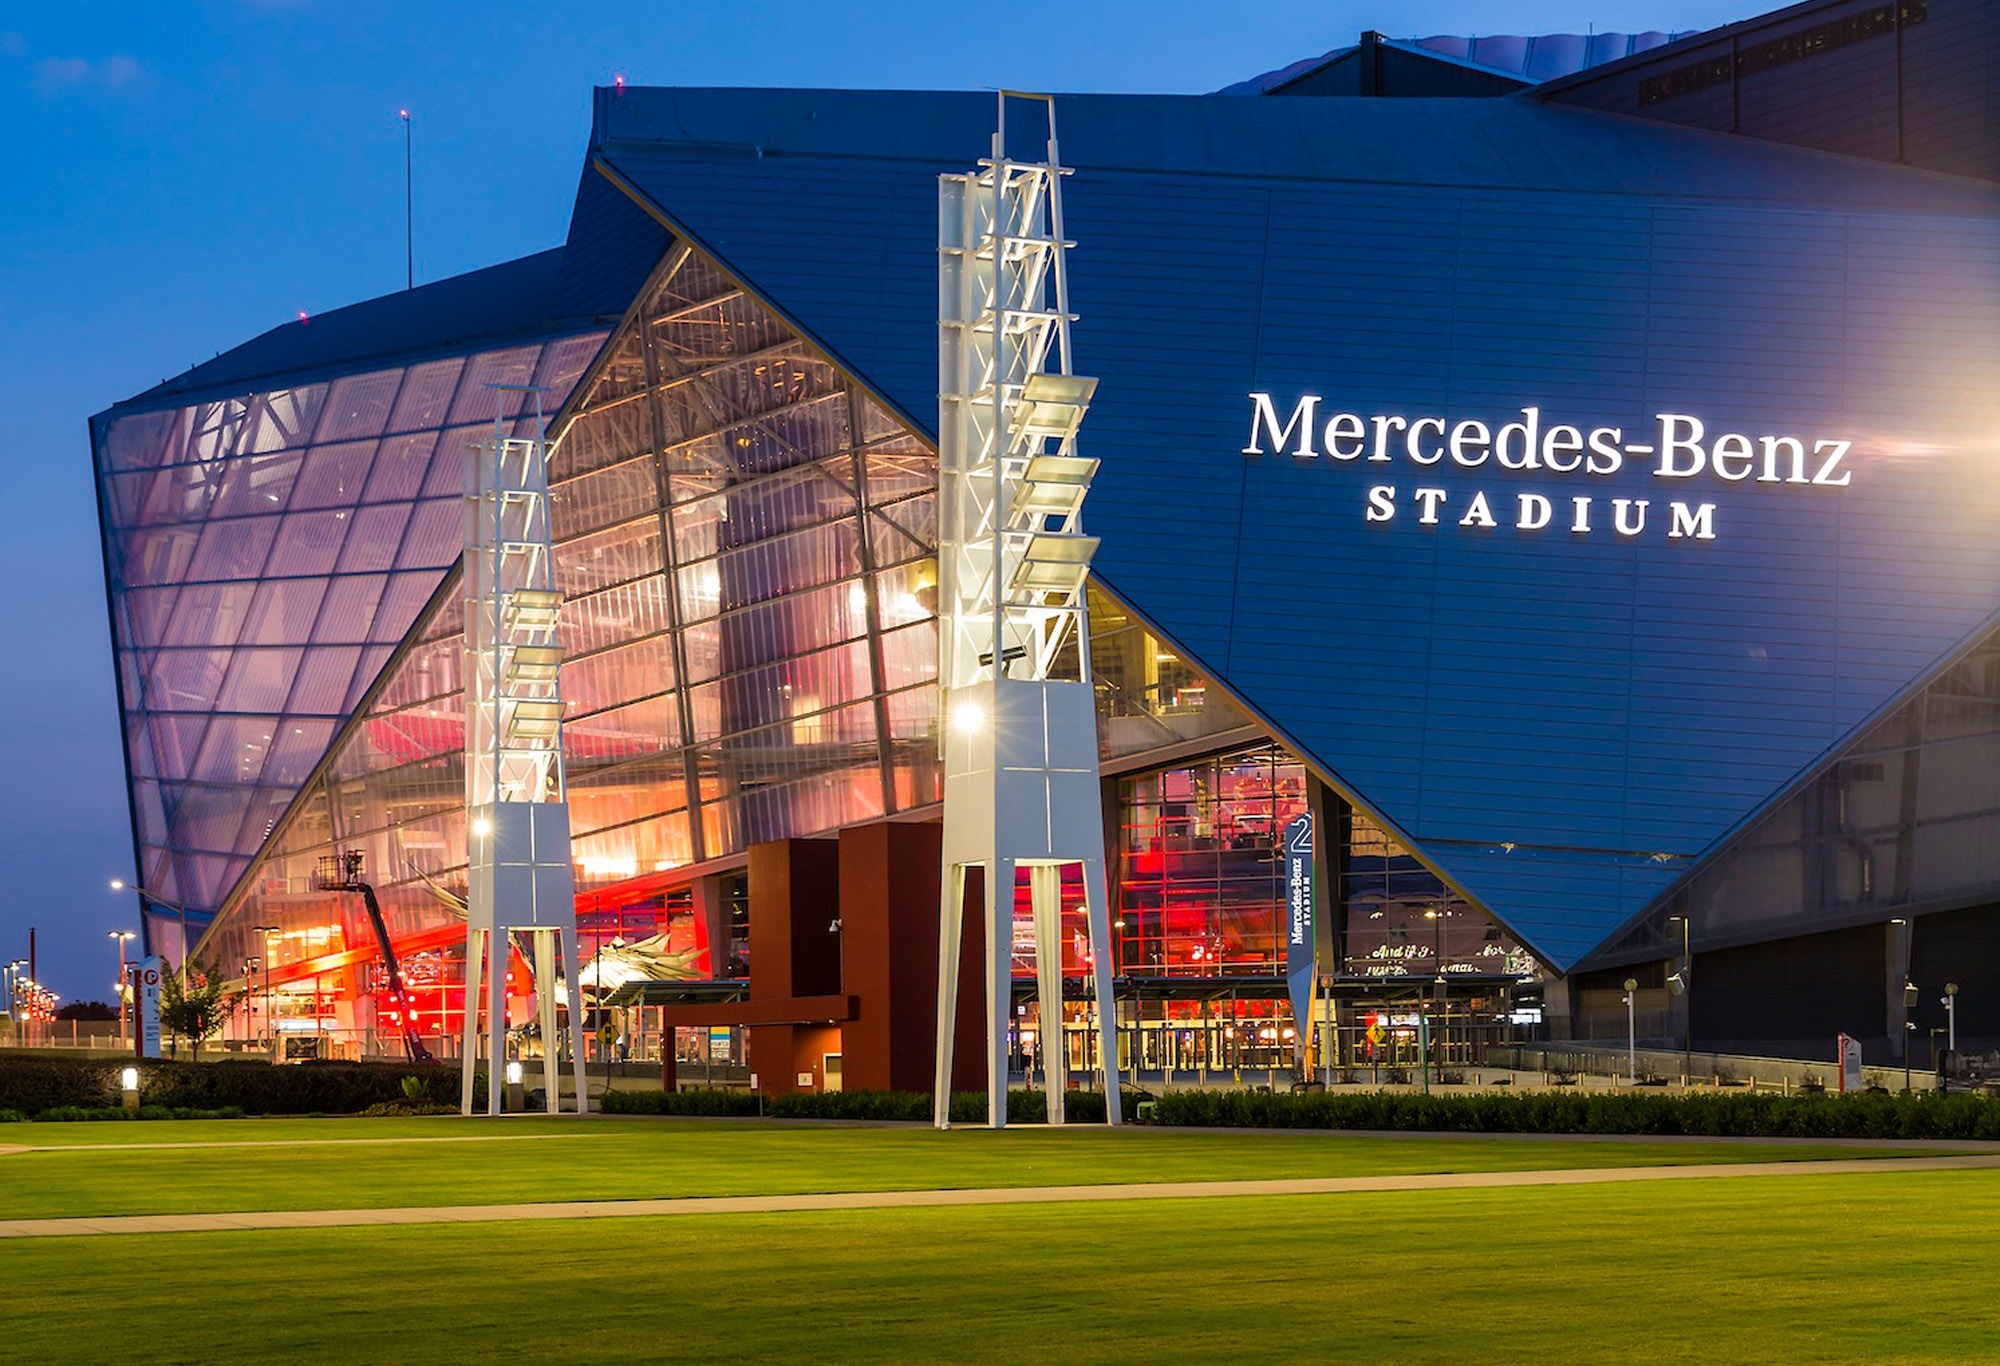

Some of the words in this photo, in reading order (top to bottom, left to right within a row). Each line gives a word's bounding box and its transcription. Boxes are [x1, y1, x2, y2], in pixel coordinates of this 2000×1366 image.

[1243, 393, 1852, 486] Mercedes-Benz
[1366, 486, 1717, 540] STADIUM
[1290, 813, 1312, 853] 2
[1290, 857, 1304, 945] Mercedes-Benz
[1303, 876, 1311, 926] STADIUM
